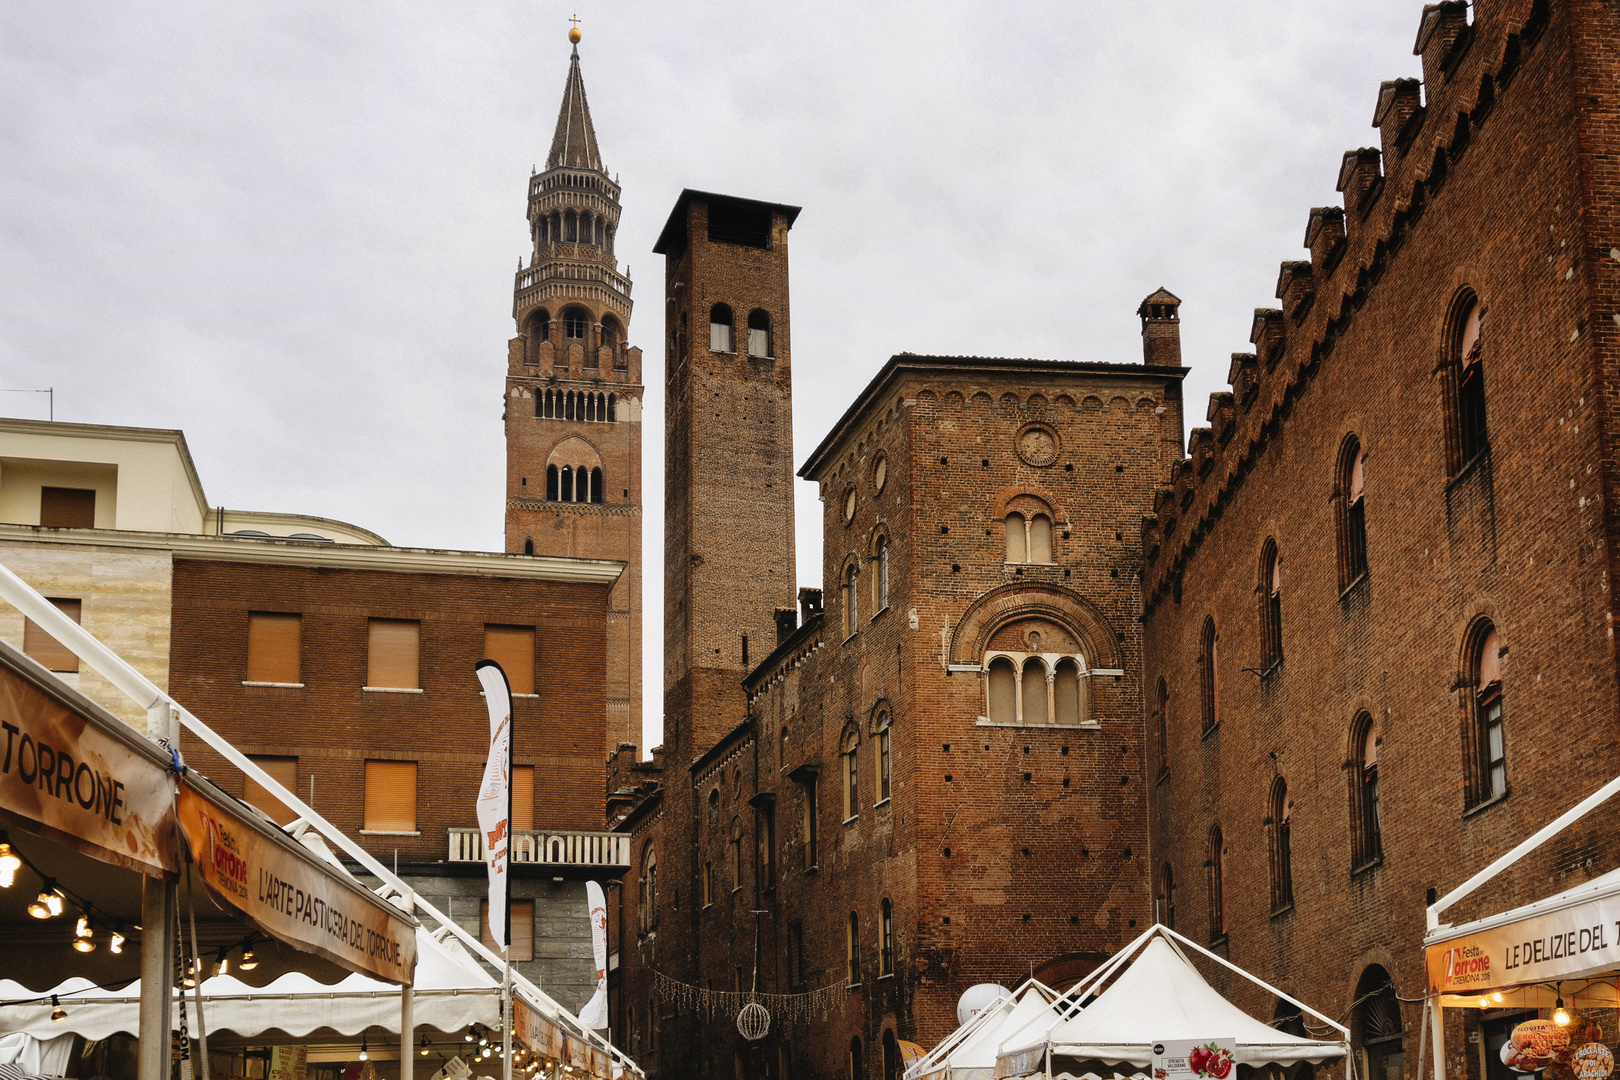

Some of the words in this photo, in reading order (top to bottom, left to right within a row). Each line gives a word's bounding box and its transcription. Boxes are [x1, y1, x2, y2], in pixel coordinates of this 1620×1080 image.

[1, 720, 124, 826] TORRONE
[258, 867, 294, 917] L'ARTE
[350, 919, 365, 952] DEL
[366, 927, 402, 968] TORRONE
[1461, 946, 1479, 959] Festa
[1505, 945, 1520, 970] LE
[1522, 931, 1576, 965] DELIZIE
[1579, 924, 1608, 954] DEL
[1453, 973, 1480, 985] CREMONA
[1575, 1046, 1610, 1060] CROCCANTE
